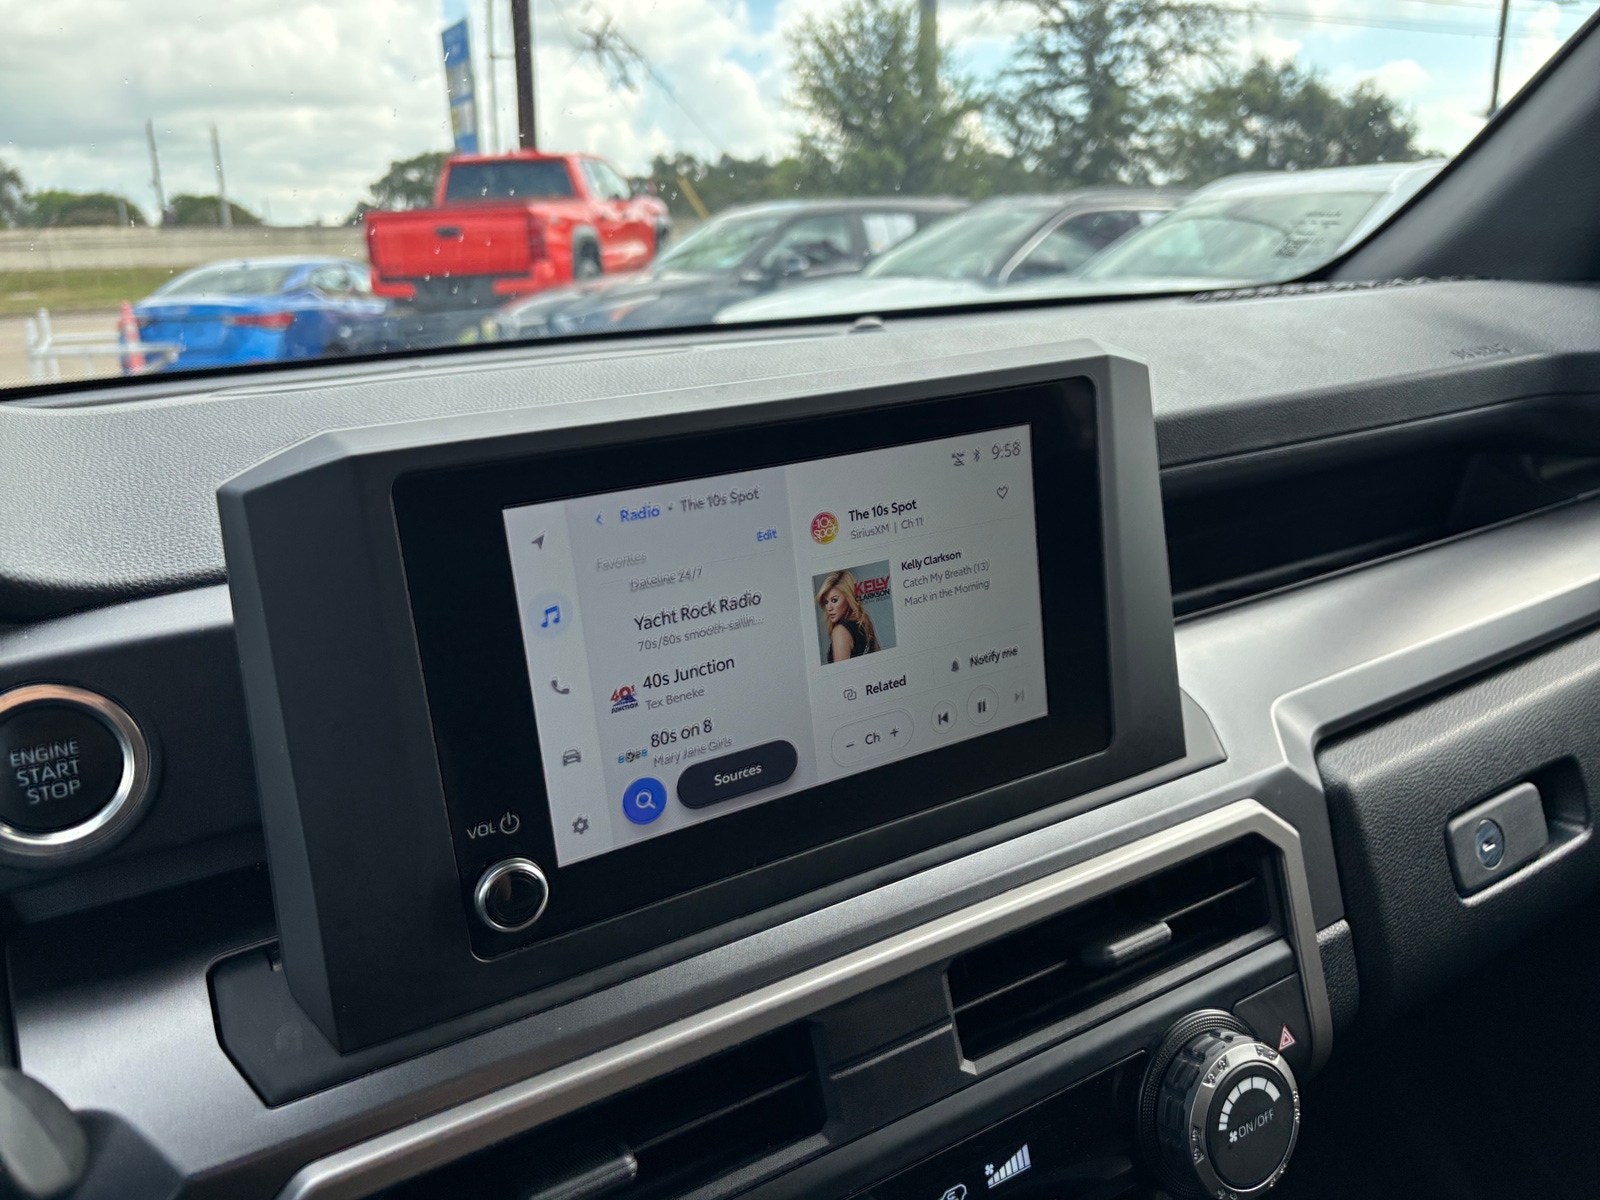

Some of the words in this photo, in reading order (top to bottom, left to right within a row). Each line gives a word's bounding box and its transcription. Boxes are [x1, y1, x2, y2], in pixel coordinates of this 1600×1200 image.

[991, 442, 1021, 460] 9:58
[620, 503, 661, 522] Radio
[681, 495, 705, 512] The
[707, 491, 727, 508] 10s
[729, 487, 760, 505] Spot
[848, 507, 869, 522] The
[871, 503, 889, 518] 10s
[891, 499, 917, 516] Spot
[757, 527, 778, 542] Edit
[851, 522, 889, 540] SiriusXM
[901, 518, 914, 530] Ch
[915, 516, 924, 526] 11
[596, 551, 647, 571] Favorites
[901, 558, 922, 571] Kelly
[924, 550, 962, 567] Clarkson
[630, 569, 676, 591] Dateline
[678, 565, 703, 584] 24/7
[853, 575, 890, 596] KELLY
[903, 576, 928, 589] Catch
[930, 571, 943, 585] My
[945, 564, 973, 580] Breath
[973, 560, 990, 575] (13)
[854, 588, 891, 602] CLARKSON
[904, 593, 928, 607] Mack
[929, 591, 938, 603] in
[939, 586, 953, 599] the
[954, 579, 990, 595] Morning
[634, 607, 678, 630] Yacht
[681, 600, 715, 622] Rock
[720, 590, 762, 612] Radio
[637, 633, 682, 652] 70s/80s
[969, 648, 1000, 667] Notify
[1002, 646, 1018, 659] me
[643, 672, 670, 689] 40s
[673, 657, 735, 683] Junction
[865, 674, 907, 696] Related
[645, 698, 663, 711] Tex
[665, 687, 705, 705] Beneke
[650, 728, 677, 748] 80s
[681, 725, 700, 740] on
[702, 717, 713, 733] 8
[864, 729, 881, 745] Ch
[10, 739, 80, 768] ENGINE
[653, 749, 681, 768] Mary
[683, 742, 707, 760] Jane
[708, 735, 733, 752] Girls
[16, 759, 80, 787] START
[713, 763, 762, 787] Sources
[27, 780, 81, 805] STOP
[466, 821, 496, 839] VOL
[1238, 1108, 1275, 1138] ON/OFF
